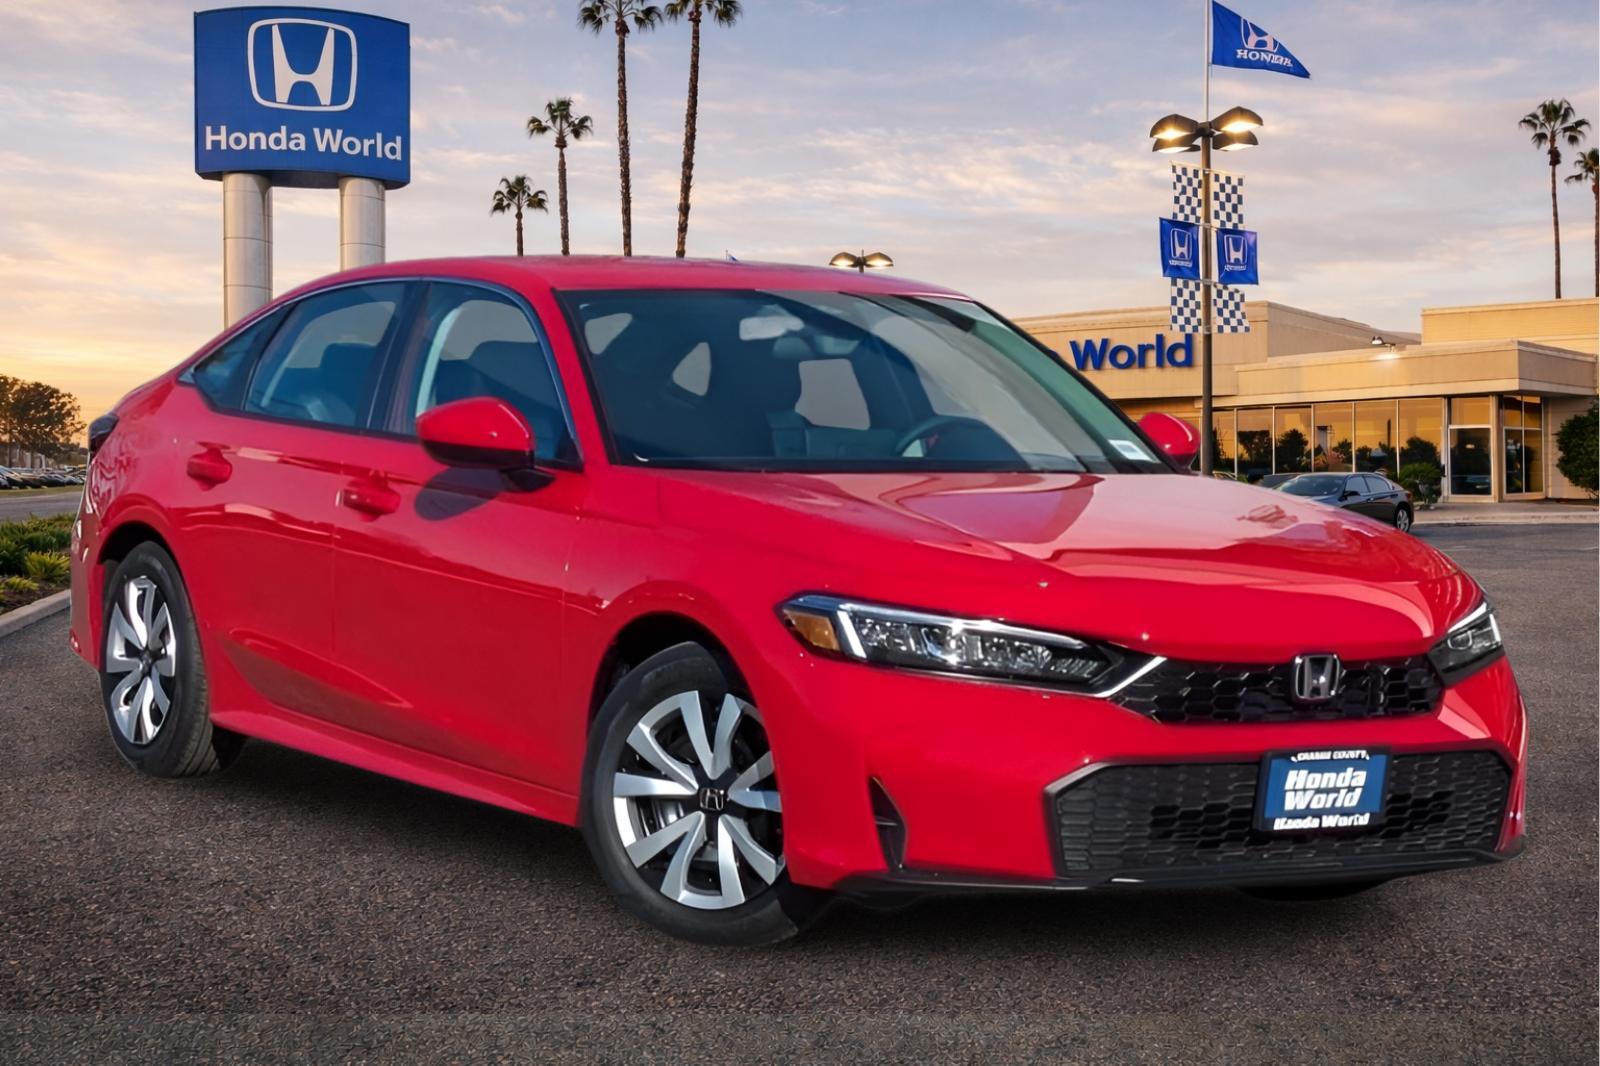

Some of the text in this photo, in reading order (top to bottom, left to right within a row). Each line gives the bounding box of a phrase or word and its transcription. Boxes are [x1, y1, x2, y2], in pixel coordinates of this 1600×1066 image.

[205, 125, 402, 161] Honda World
[1069, 333, 1194, 371] World
[1284, 767, 1367, 790] Honda
[1284, 787, 1363, 811] World
